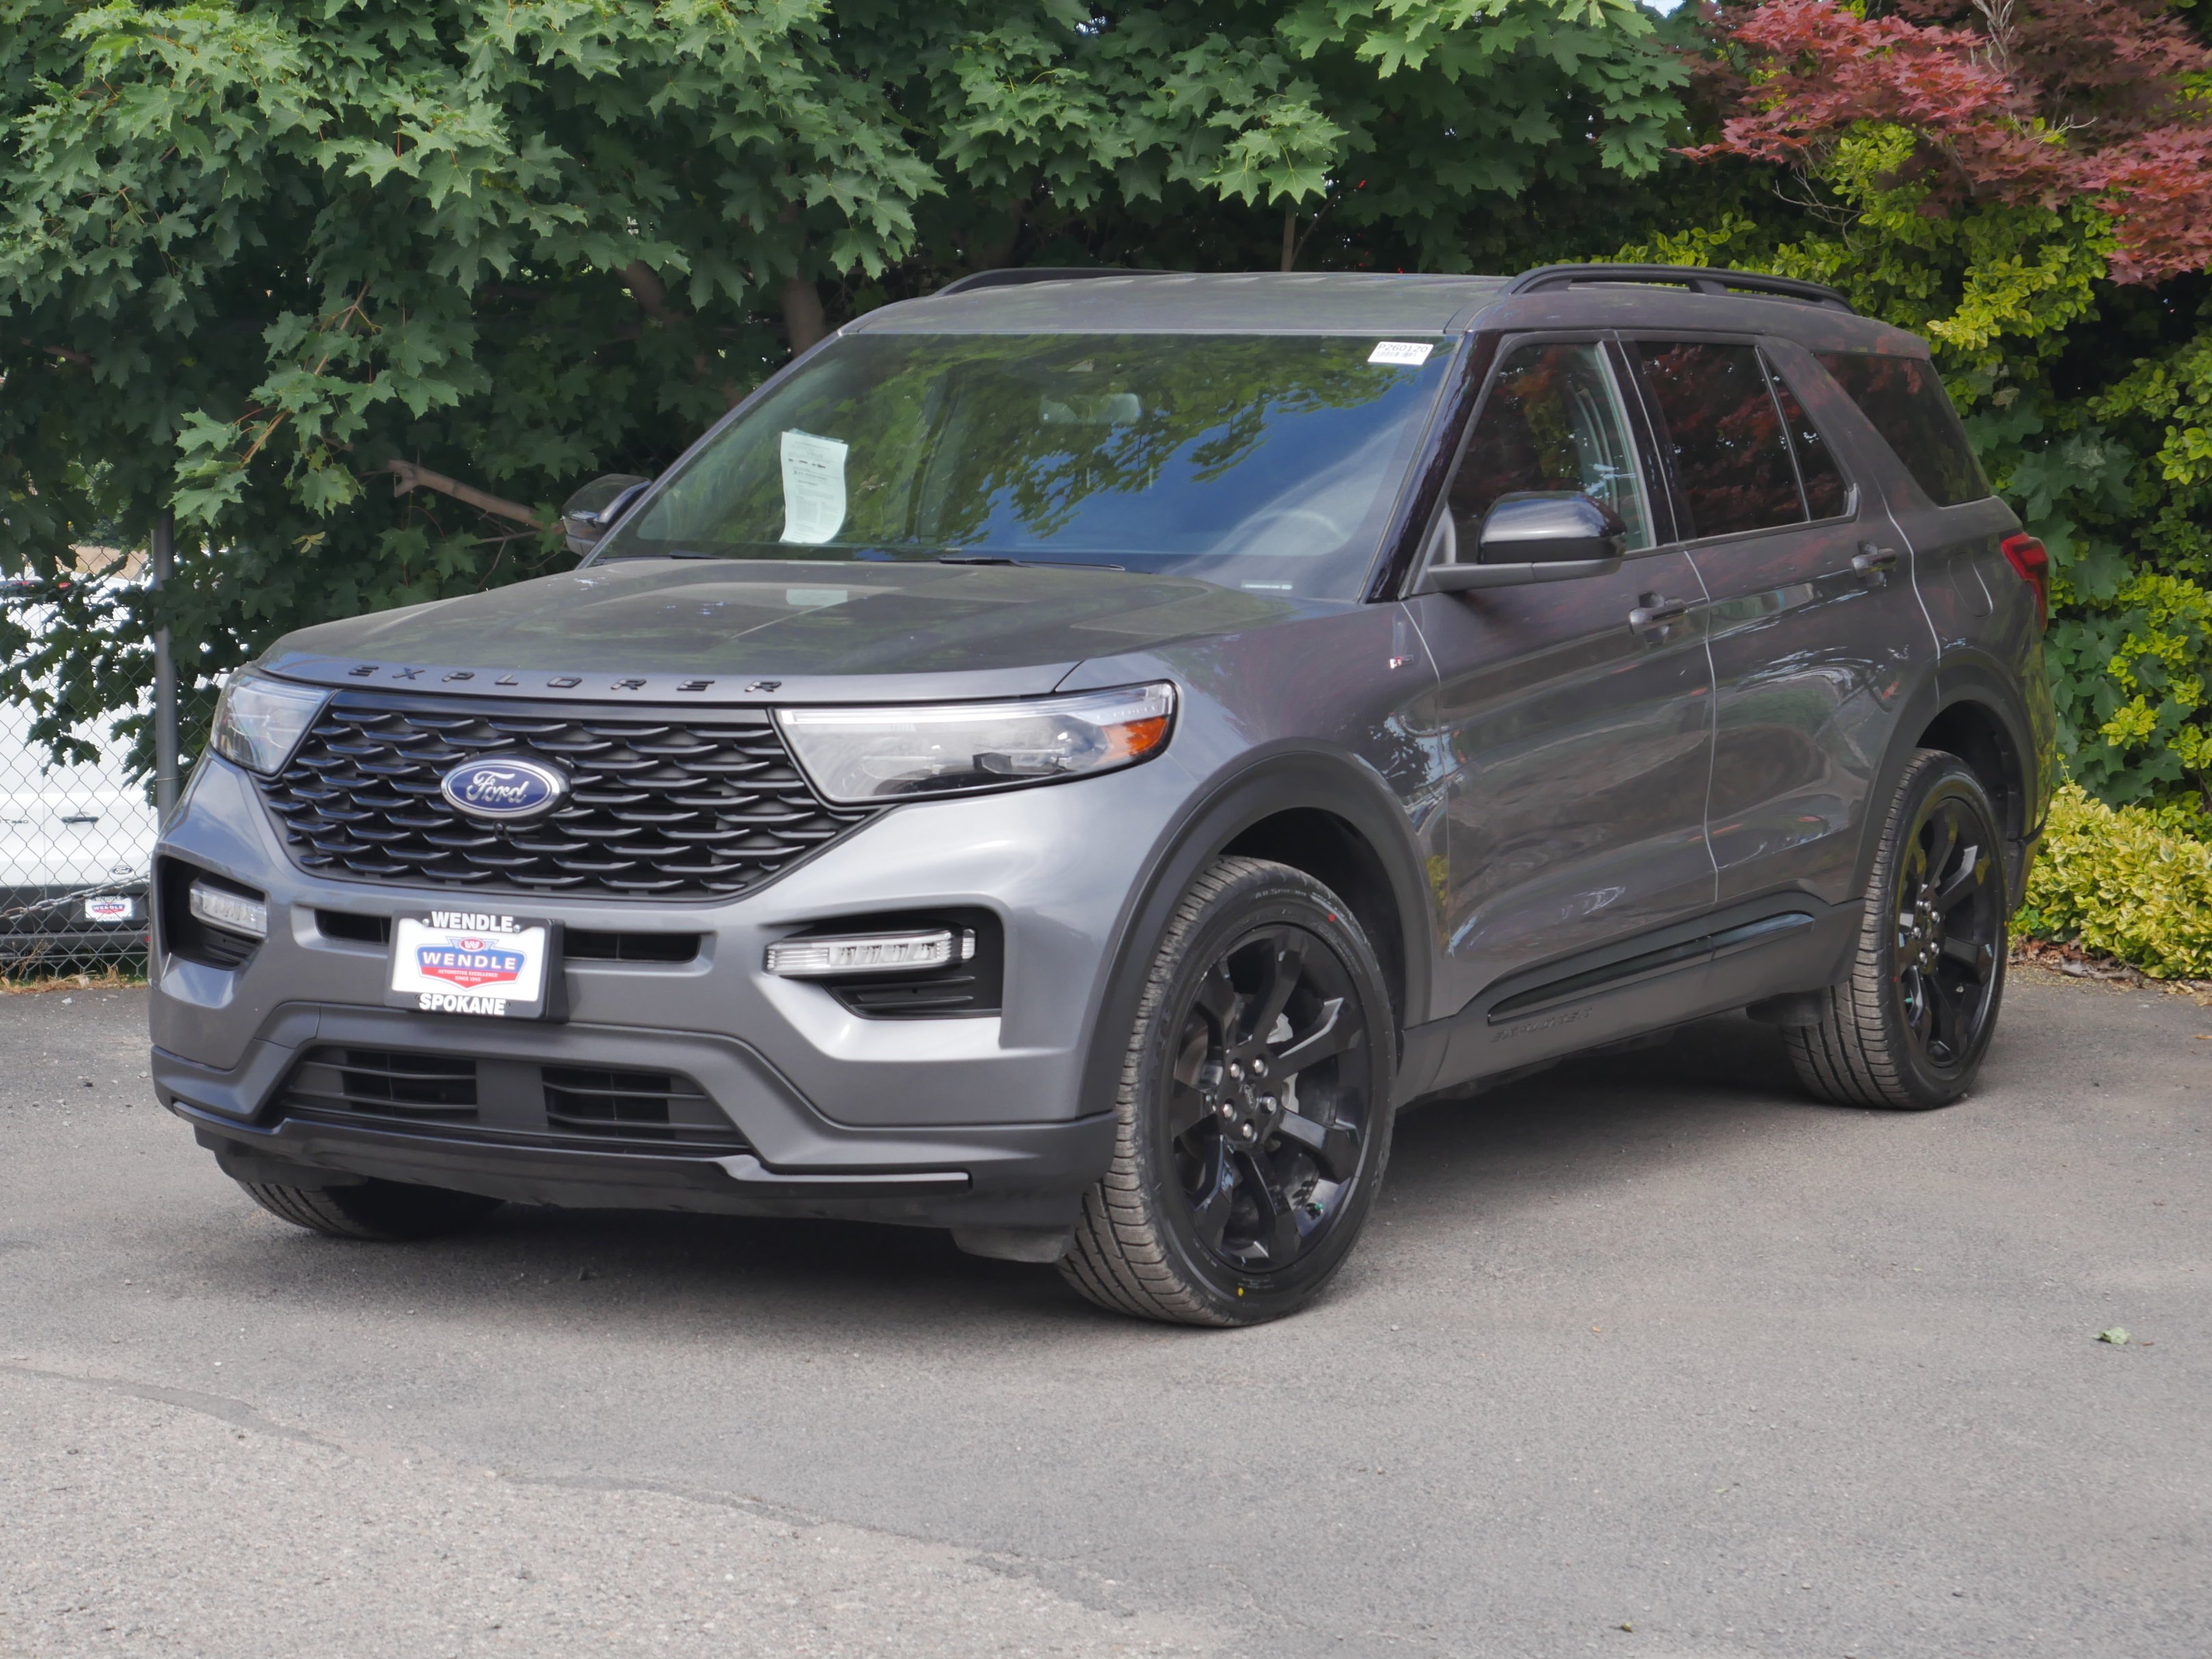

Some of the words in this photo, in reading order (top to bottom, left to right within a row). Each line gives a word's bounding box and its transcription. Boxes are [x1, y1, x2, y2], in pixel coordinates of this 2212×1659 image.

[1377, 344, 1428, 353] P260120
[348, 665, 782, 693] EXPLORER
[465, 770, 526, 804] Ford
[431, 911, 513, 932] WENDLE
[422, 952, 517, 970] WENDLE
[420, 993, 506, 1015] SPOKANE
